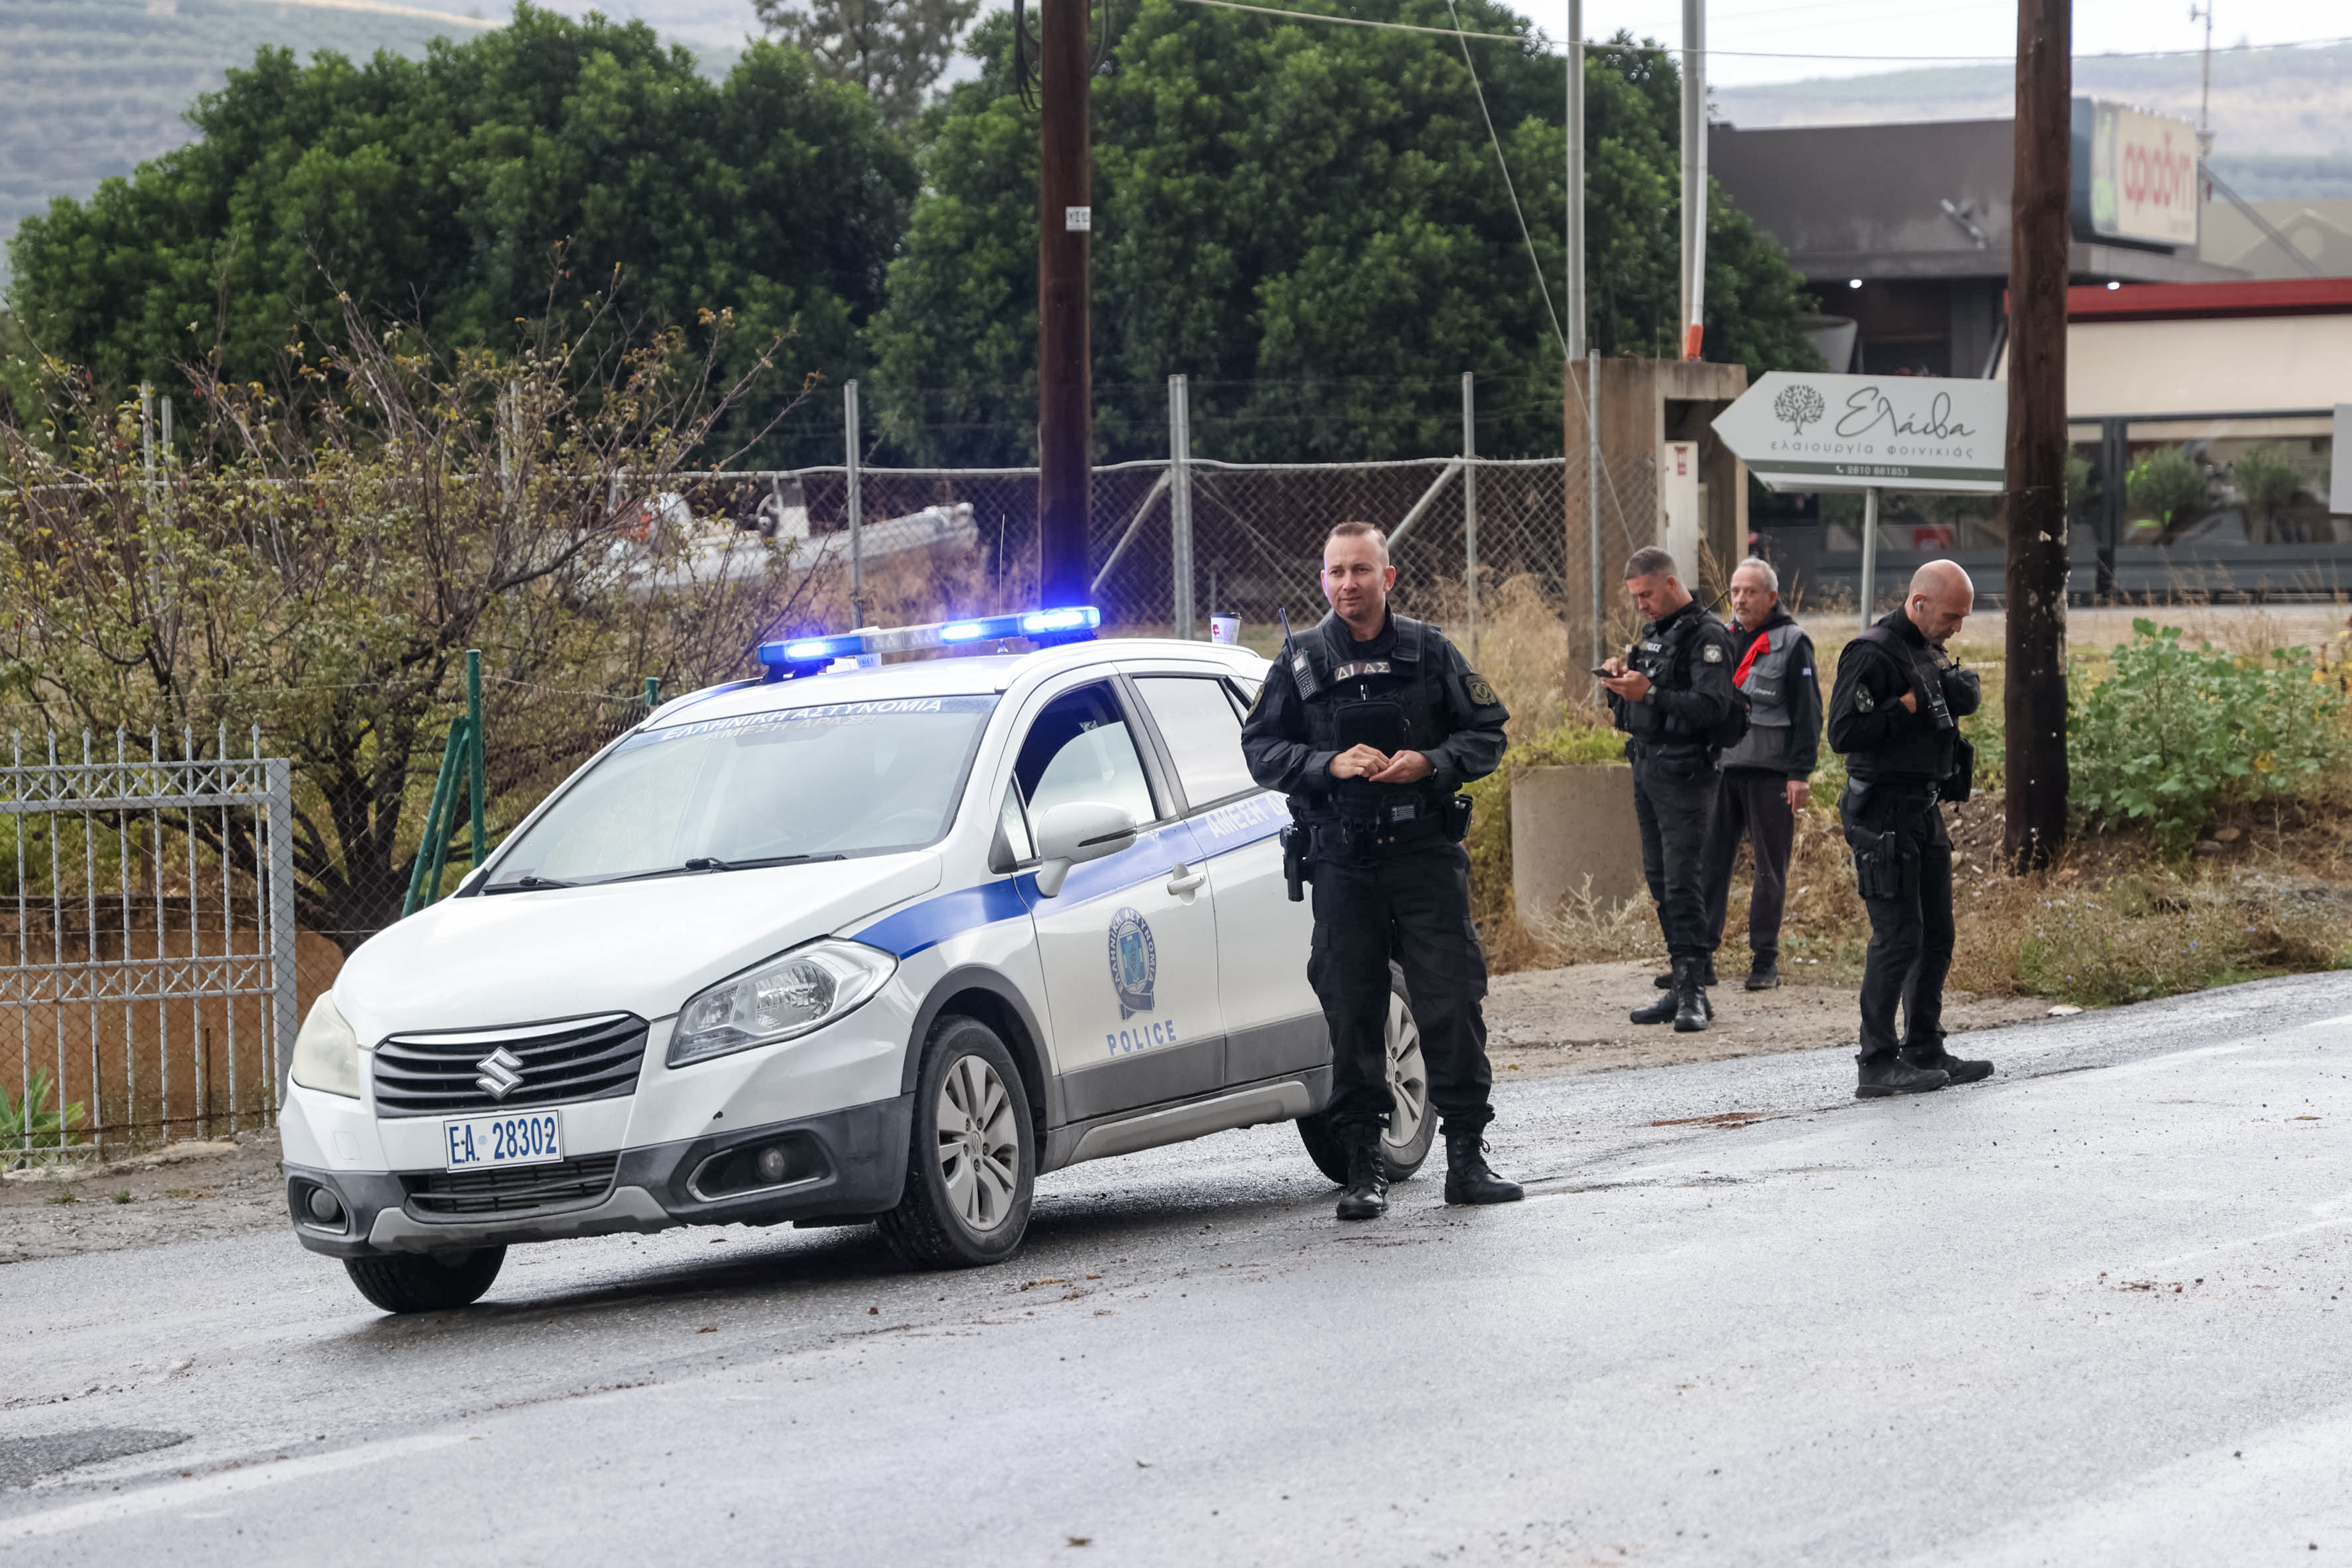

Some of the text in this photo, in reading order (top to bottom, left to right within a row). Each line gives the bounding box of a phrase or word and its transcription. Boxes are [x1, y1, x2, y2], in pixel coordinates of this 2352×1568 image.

[1771, 440, 1974, 459] ελαιουργία φοινικιάς
[661, 700, 941, 740] ΕΛΛΗΝΙΚΗ ΑΣΤΥΝΟΜΙΑ
[703, 722, 791, 741] ΑΜΕΣΗ
[1206, 800, 1270, 838] ΑΜΕΣΗ
[1107, 1020, 1176, 1056] POLICE
[492, 1117, 557, 1160] 28302
